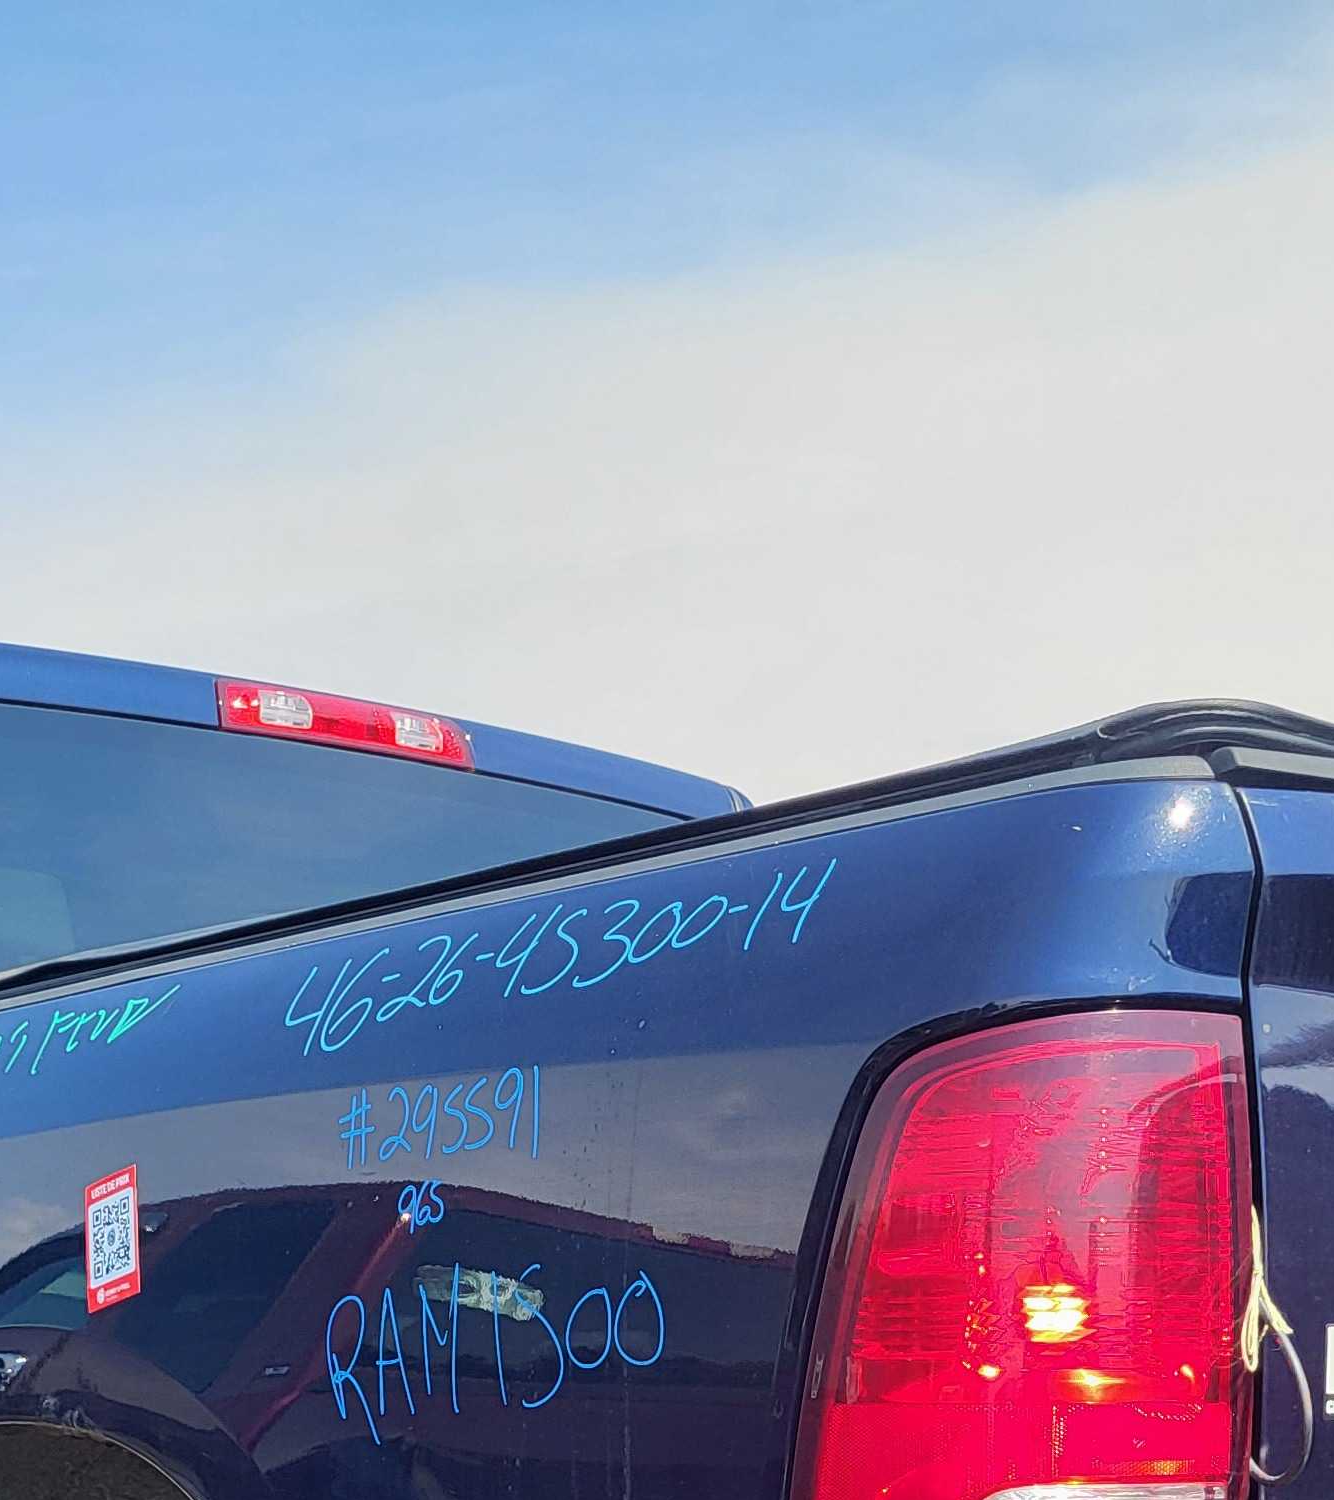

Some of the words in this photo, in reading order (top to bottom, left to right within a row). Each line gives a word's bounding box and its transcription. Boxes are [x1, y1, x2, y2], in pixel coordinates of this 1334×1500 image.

[338, 1064, 541, 1169] #295591
[397, 1177, 445, 1235] 965
[326, 1262, 461, 1446] RAM
[490, 1262, 665, 1409] 1500
